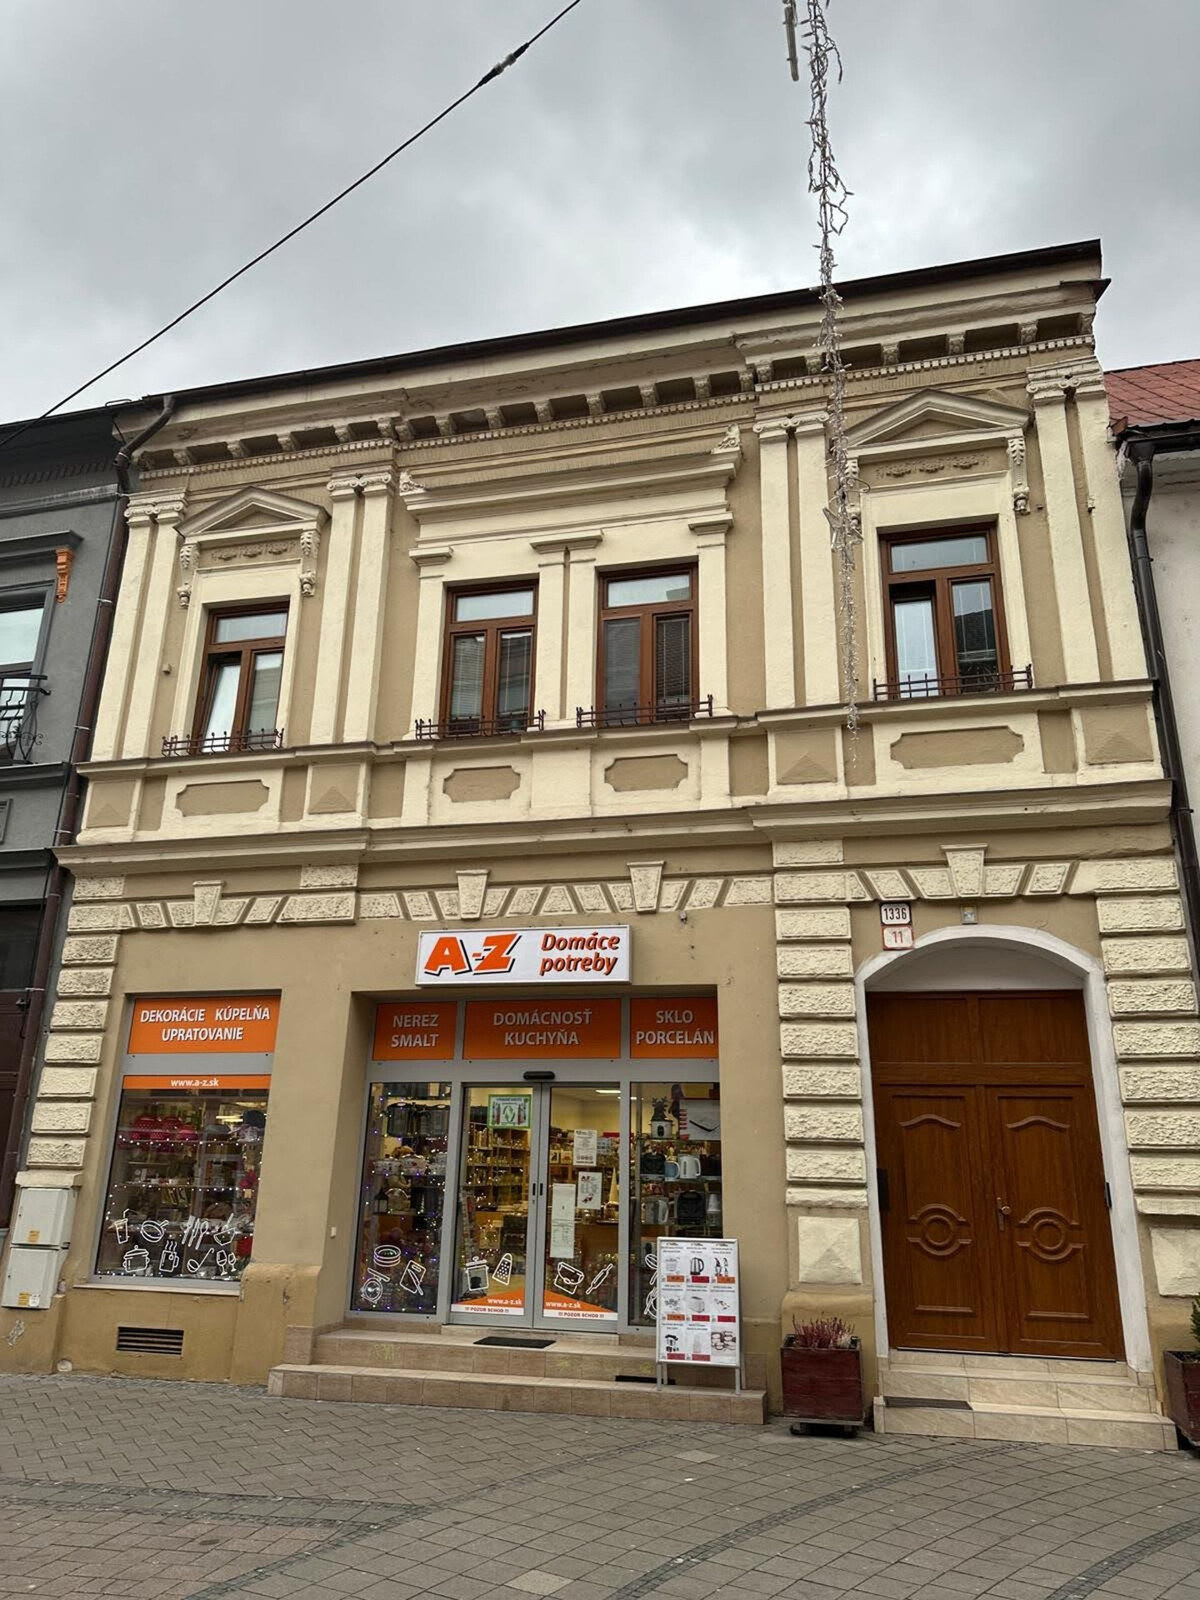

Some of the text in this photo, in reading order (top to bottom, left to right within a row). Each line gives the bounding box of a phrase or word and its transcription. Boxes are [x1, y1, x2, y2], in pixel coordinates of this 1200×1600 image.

[884, 908, 907, 920] 1336
[540, 931, 621, 951] Domáce
[892, 931, 903, 943] 11
[424, 932, 522, 976] A-Z
[539, 952, 619, 976] potreby
[140, 1006, 206, 1023] DEKORÁCIE
[392, 1013, 440, 1028] NEREZ
[493, 1009, 593, 1026] DOMÁCNOSŤ
[655, 1009, 694, 1024] SKLO
[161, 1027, 244, 1042] UPRATOVANIE
[390, 1033, 440, 1048] SMALT
[503, 1028, 580, 1046] KUCHYŇA
[635, 1028, 715, 1045] PORCELÁN
[170, 1077, 220, 1087] www.a-z.sk
